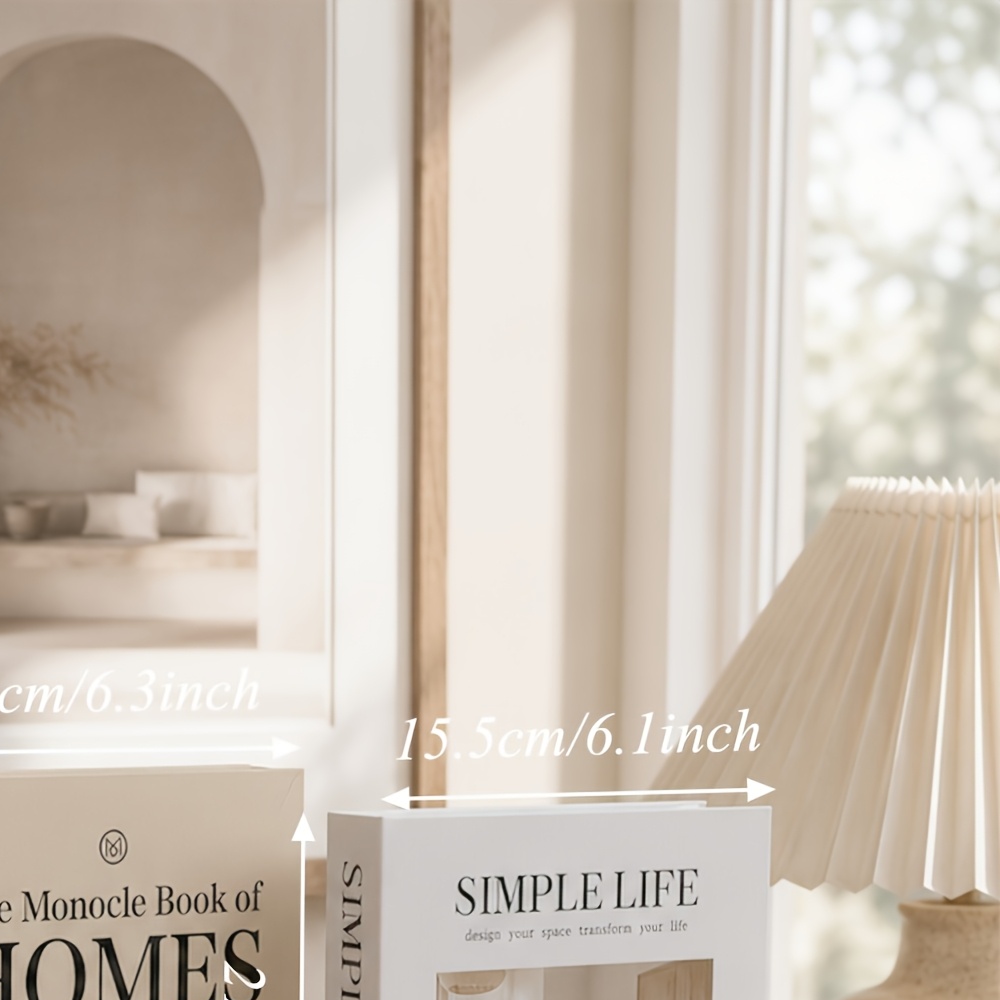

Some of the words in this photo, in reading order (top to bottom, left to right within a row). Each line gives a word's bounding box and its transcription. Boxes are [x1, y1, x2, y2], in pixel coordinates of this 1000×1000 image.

[21, 886, 147, 923] Monocle
[155, 883, 228, 918] Book
[235, 880, 265, 913] of
[454, 869, 604, 917] SIMPLE
[613, 867, 700, 911] LIFE
[464, 927, 502, 944] design
[508, 928, 535, 943] your
[541, 926, 573, 941] space
[579, 922, 633, 937] transform
[639, 922, 664, 937] your
[669, 919, 689, 933] life
